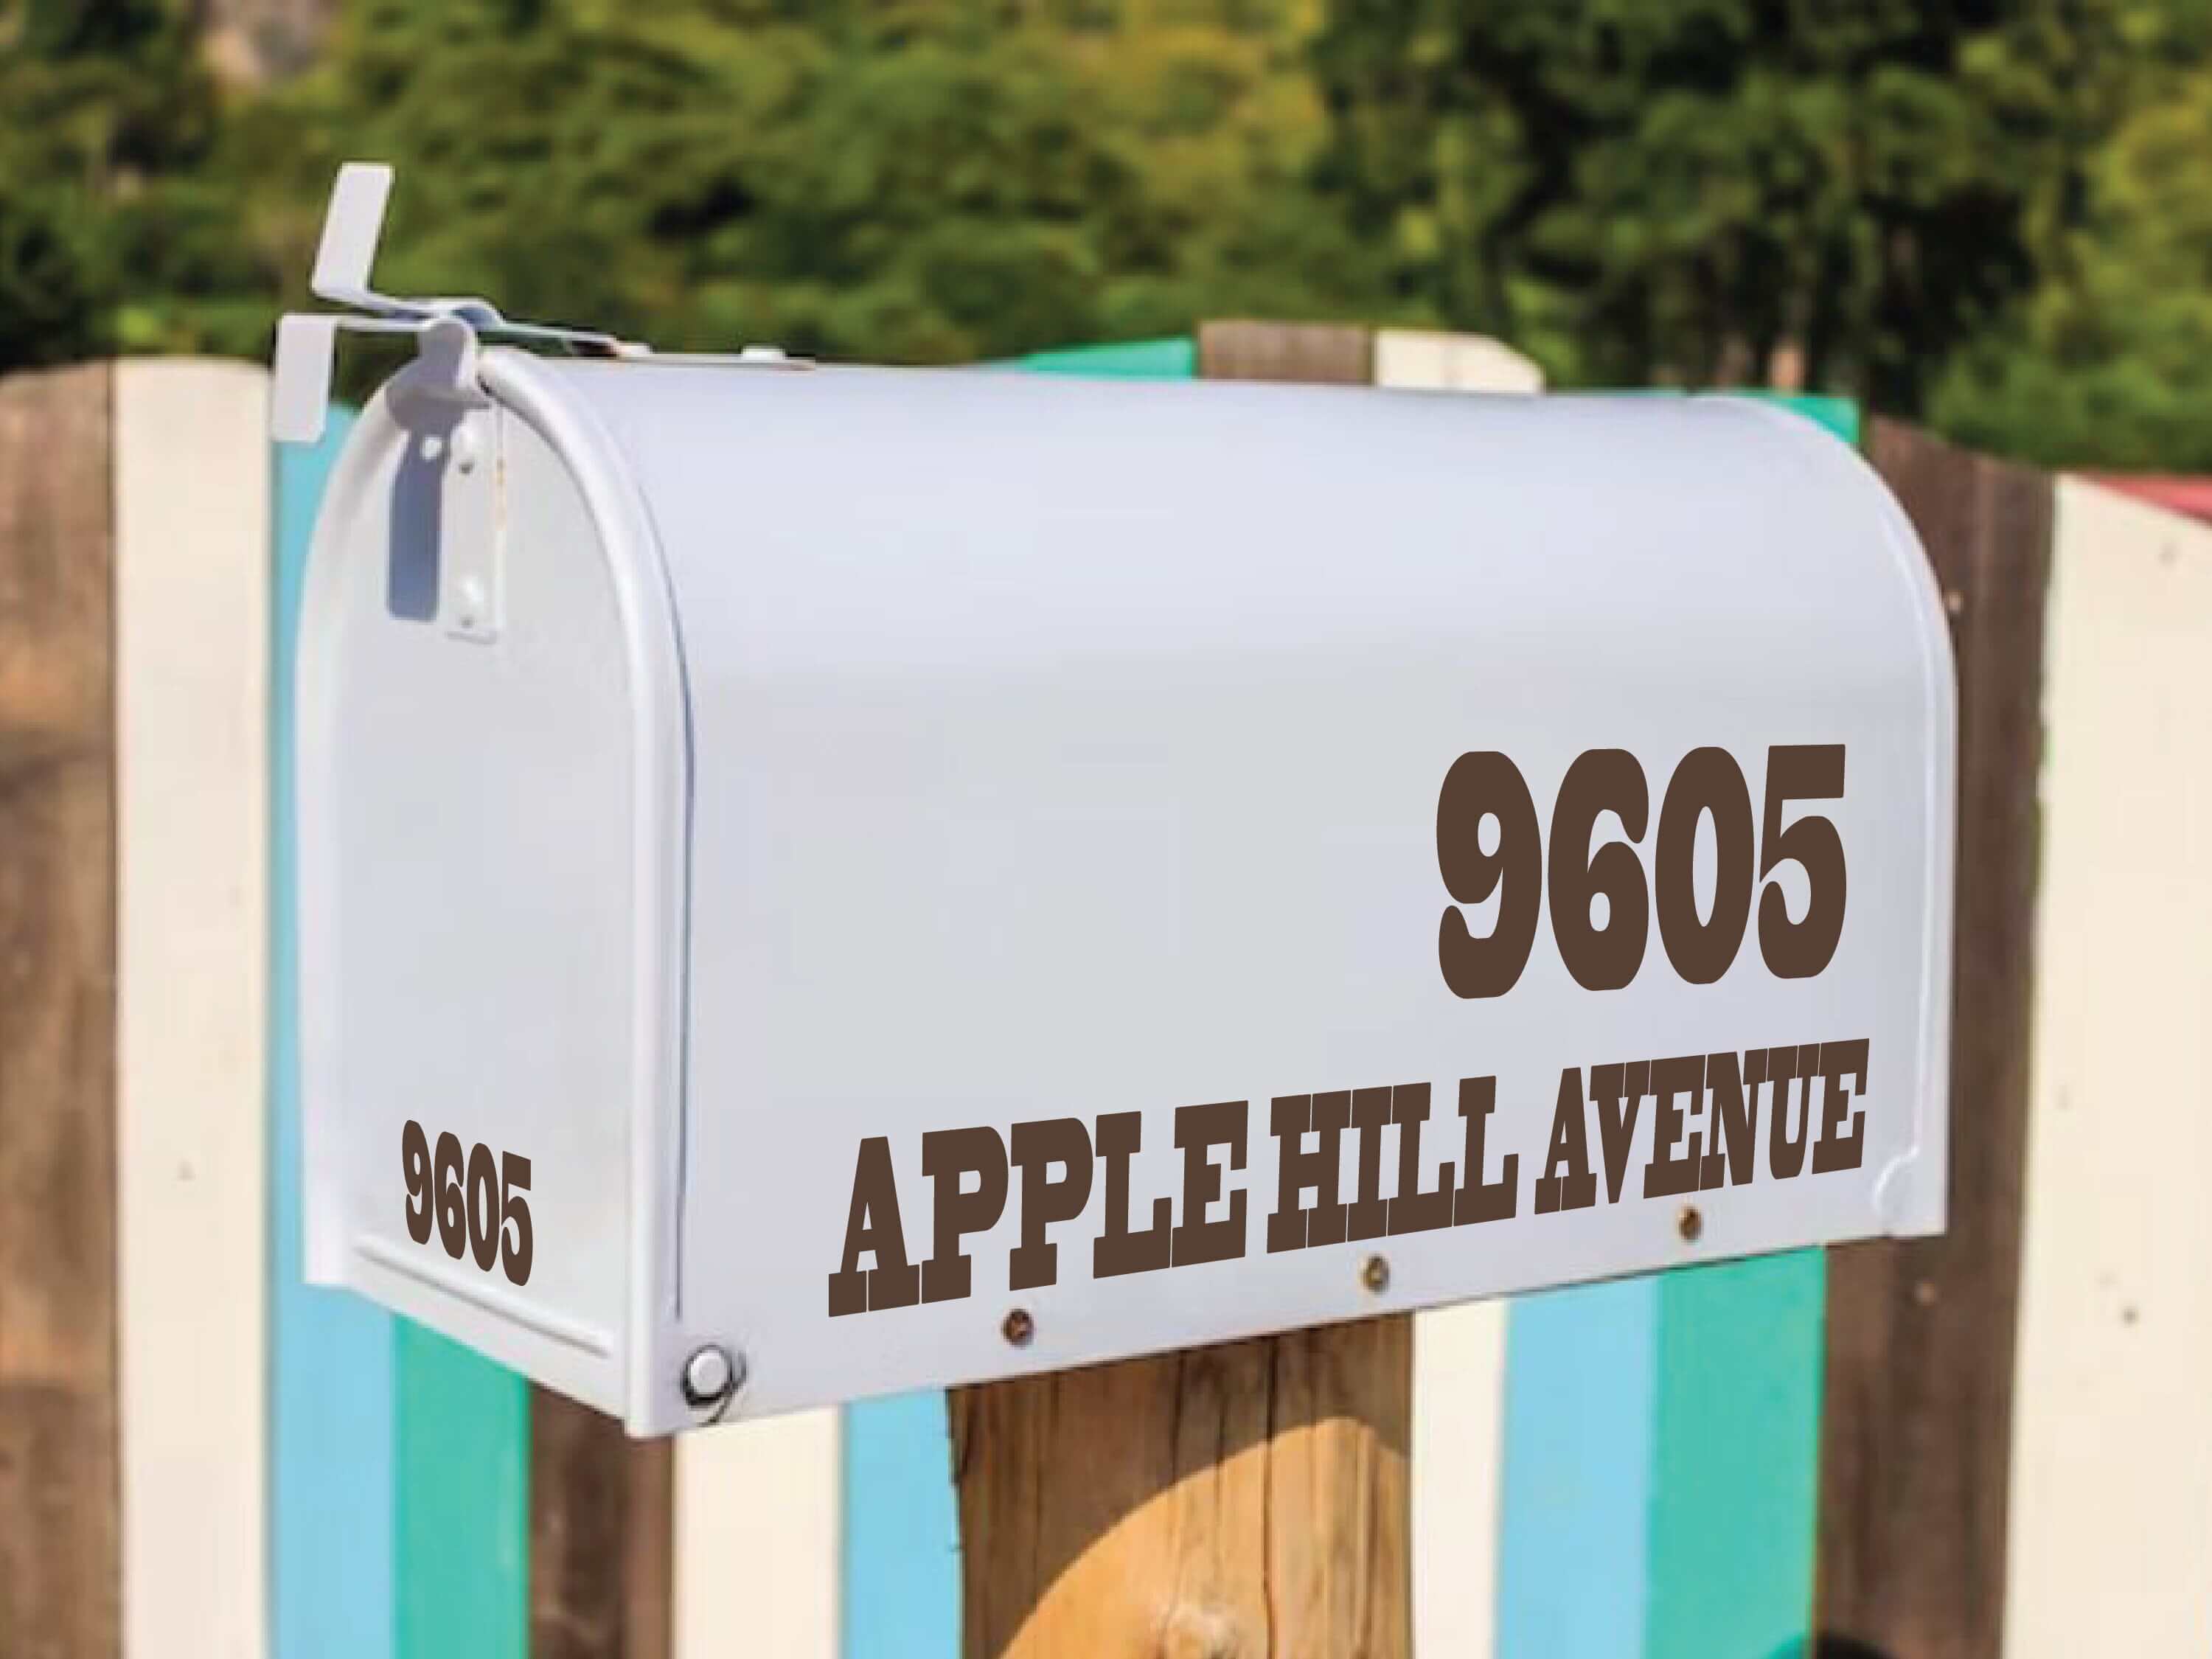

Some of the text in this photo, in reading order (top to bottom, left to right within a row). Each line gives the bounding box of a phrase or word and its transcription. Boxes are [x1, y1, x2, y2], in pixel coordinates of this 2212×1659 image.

[1436, 744, 1847, 999] 9605
[402, 1119, 533, 1287] 9605
[828, 1038, 1870, 1317] APPLE HILL AVENUE
